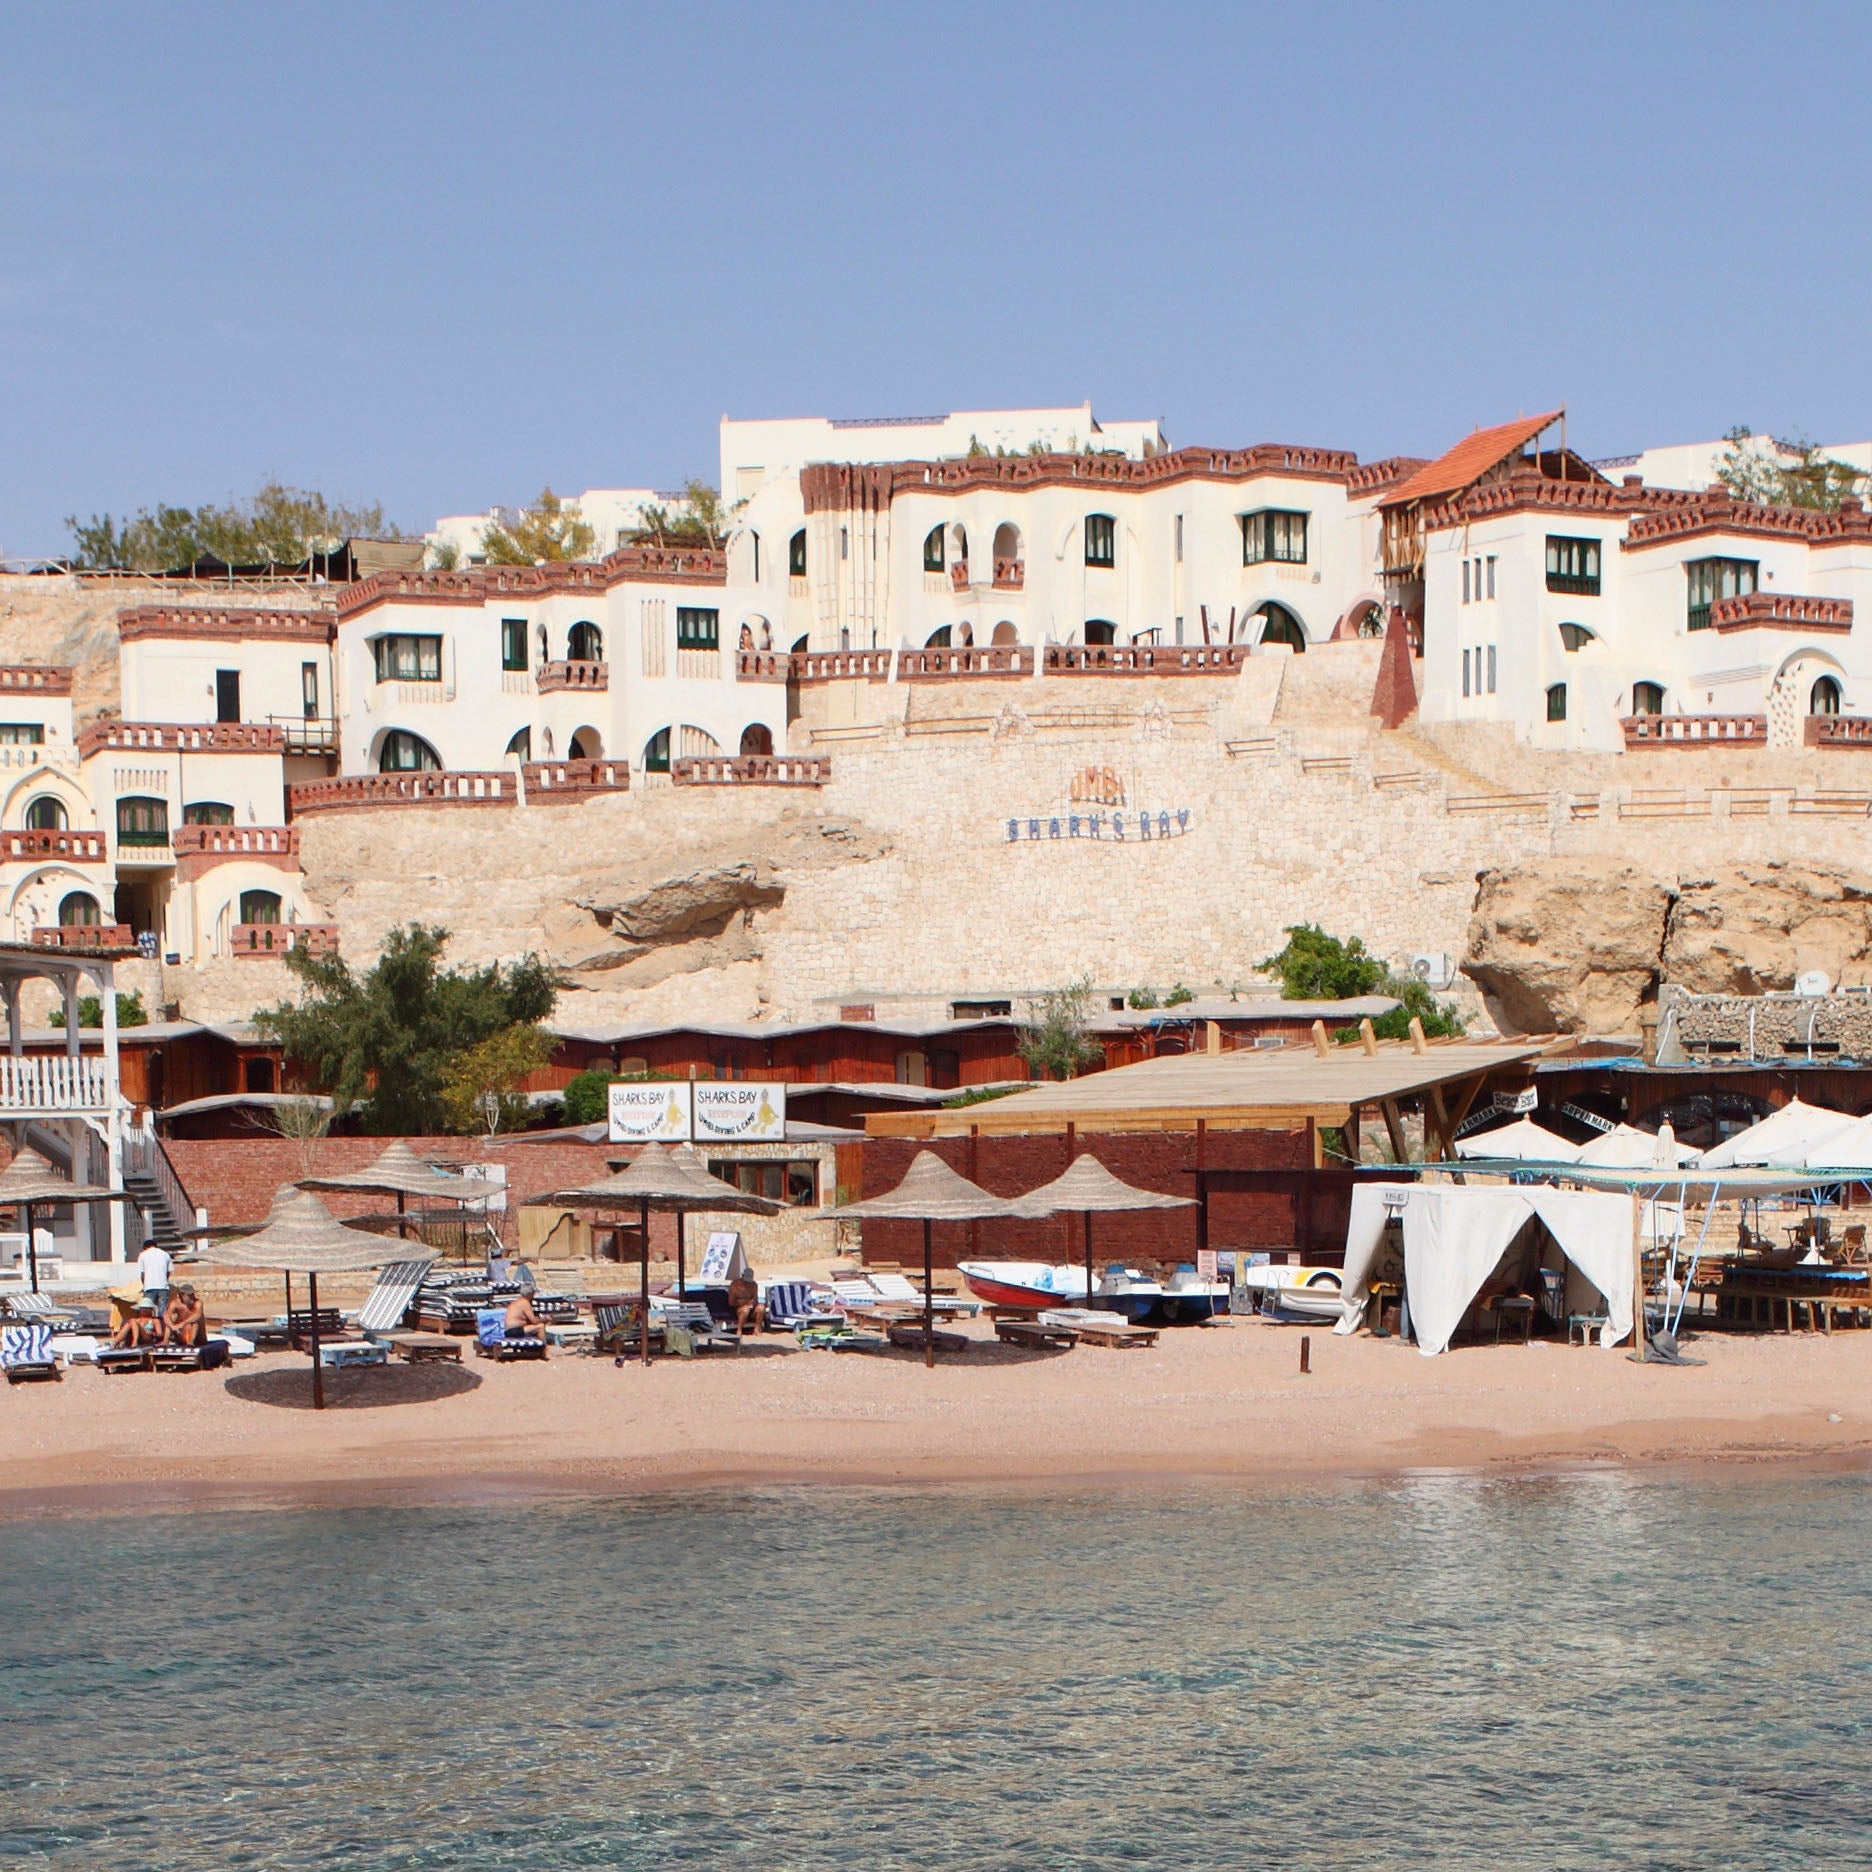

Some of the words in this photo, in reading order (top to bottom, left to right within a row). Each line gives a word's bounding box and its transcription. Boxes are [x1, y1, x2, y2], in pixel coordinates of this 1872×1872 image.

[1009, 810, 1125, 843] SHARK'S
[1140, 808, 1191, 841] BAY
[613, 1092, 647, 1106] SHARKS
[649, 1091, 665, 1104] BAY
[698, 1090, 737, 1104] SHARKS
[739, 1091, 757, 1104] BAY
